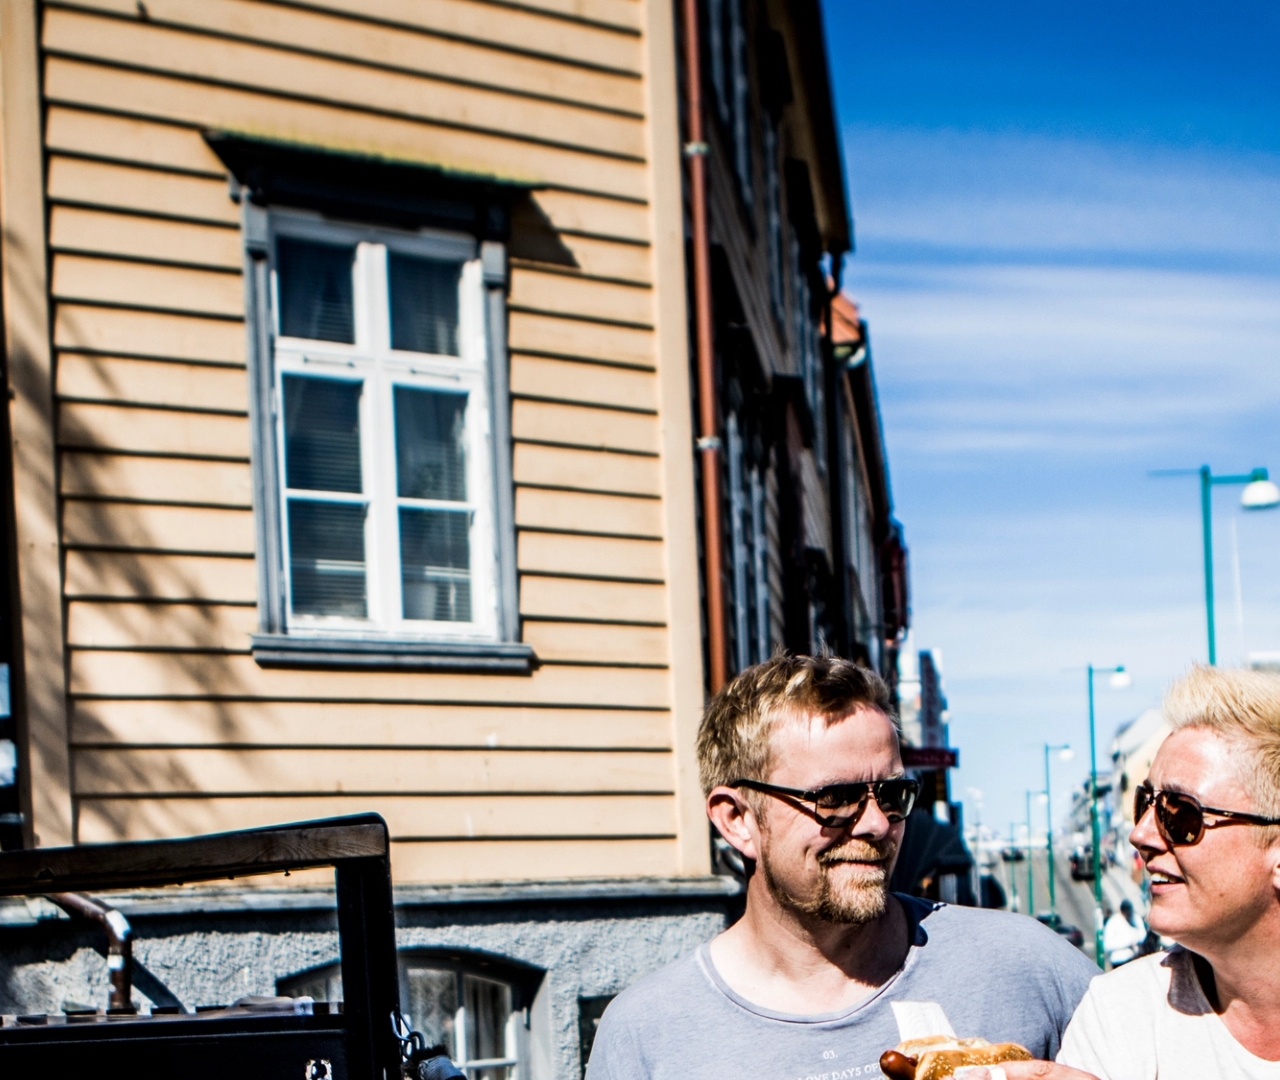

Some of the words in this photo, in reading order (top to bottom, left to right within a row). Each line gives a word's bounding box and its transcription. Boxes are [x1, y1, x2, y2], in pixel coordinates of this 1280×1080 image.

[822, 1050, 839, 1060] 03.
[832, 1067, 862, 1080] DAYS
[864, 1062, 881, 1074] OF
